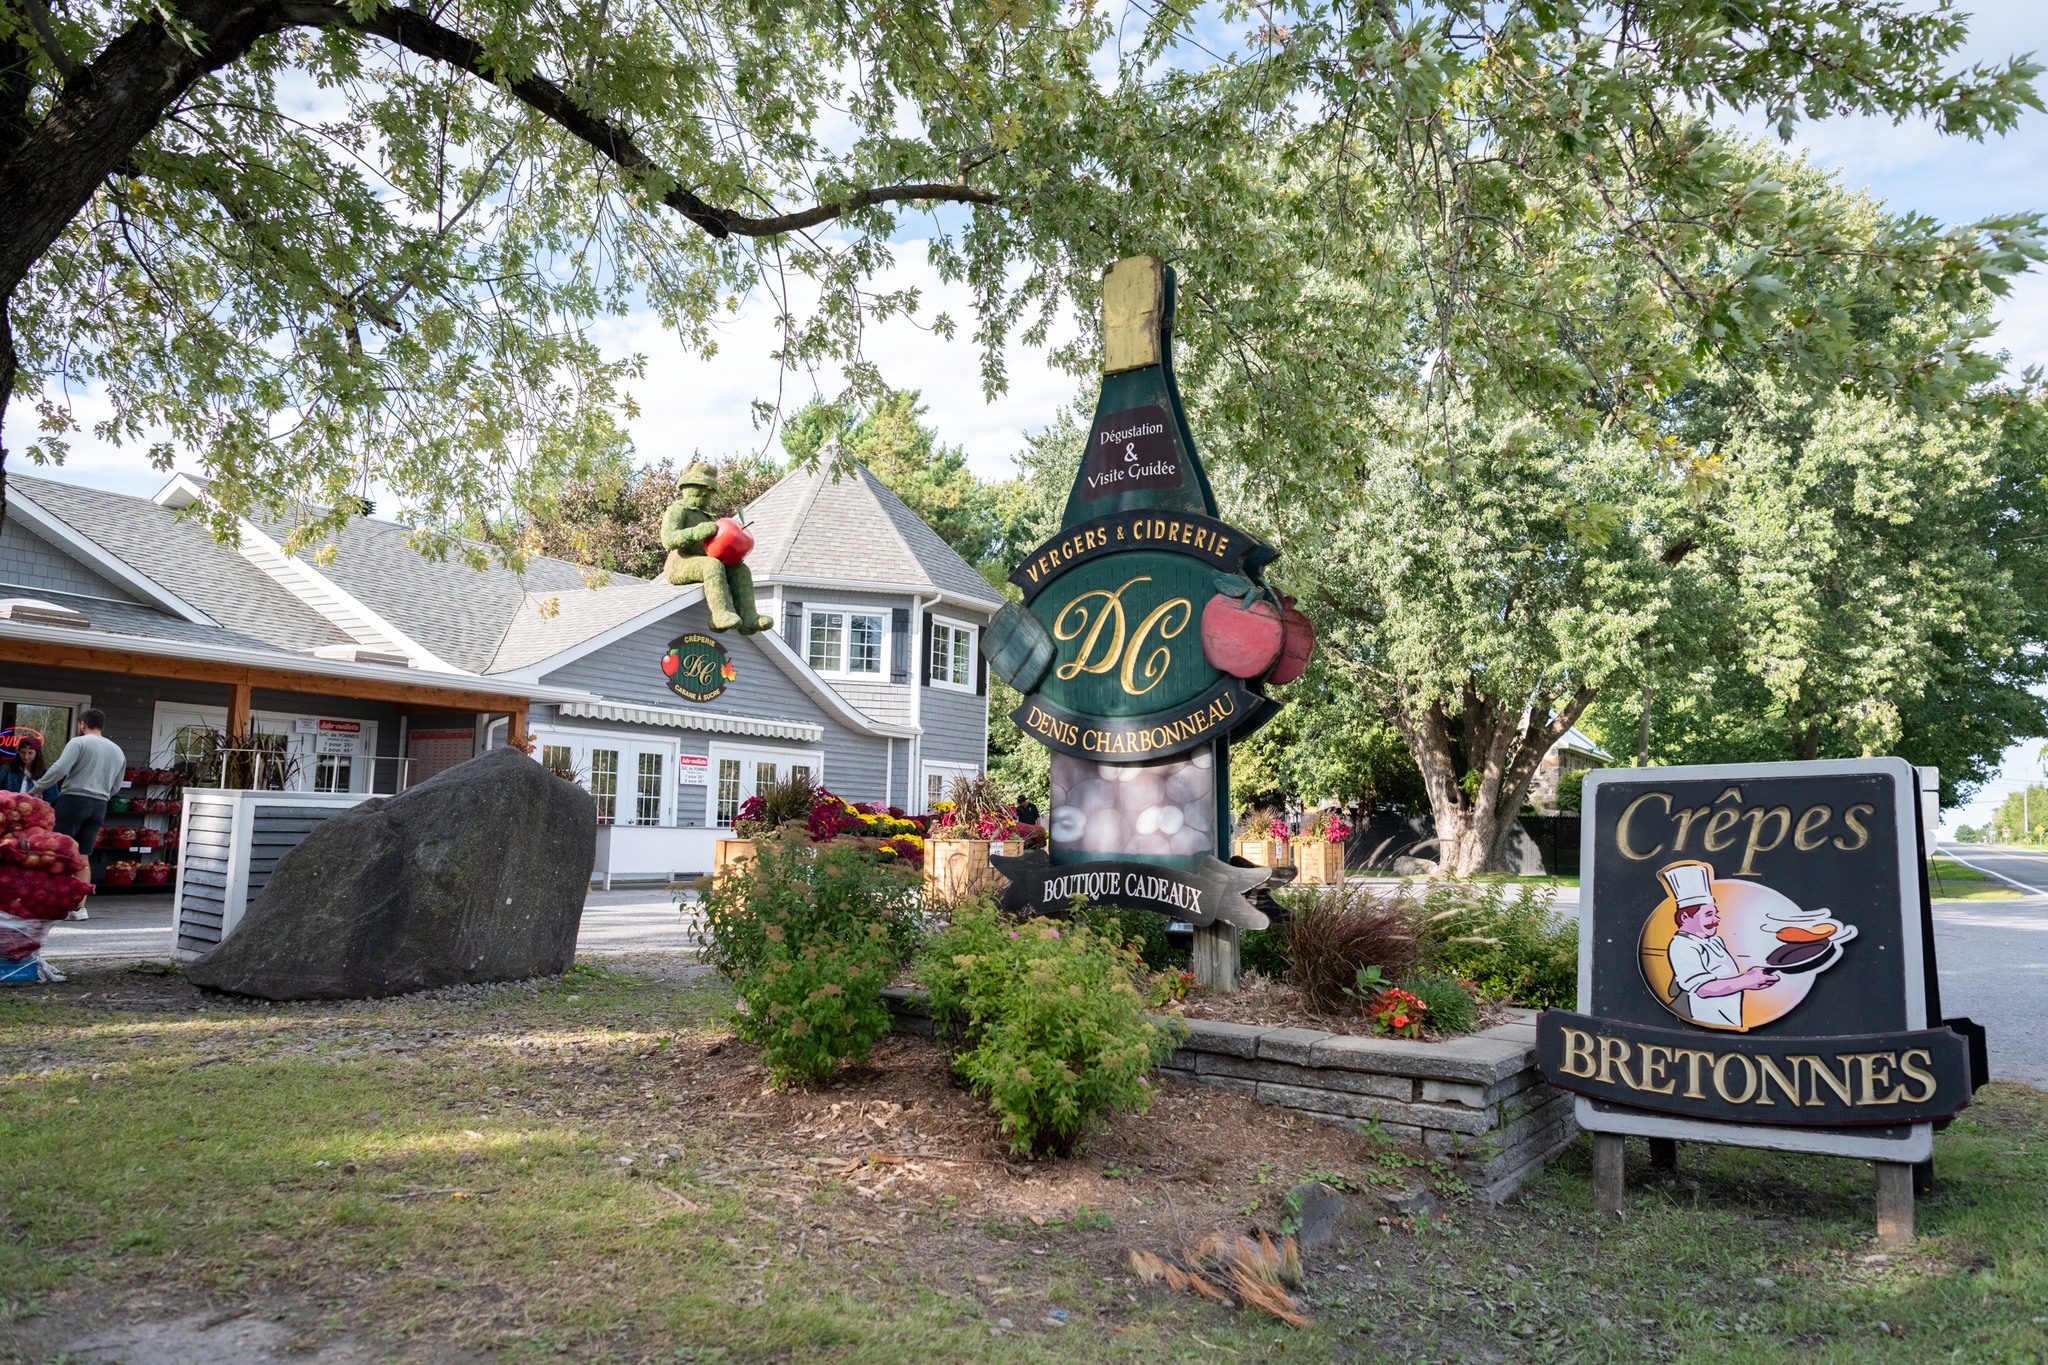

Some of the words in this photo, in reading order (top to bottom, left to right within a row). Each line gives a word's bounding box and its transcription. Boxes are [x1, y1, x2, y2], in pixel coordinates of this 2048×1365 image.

[1100, 422, 1163, 445] Dégustation
[1124, 442, 1138, 462] &
[1088, 468, 1124, 488] Visite
[1128, 460, 1176, 480] Guidée
[1026, 525, 1108, 583] VERGERS
[1116, 525, 1125, 540] &
[1133, 519, 1231, 558] CIDRERIE
[684, 634, 716, 648] CRÊPERIE
[674, 684, 697, 700] CABANE
[703, 688, 721, 701] SUCRE
[1025, 705, 1079, 746] DENIS
[1082, 691, 1236, 754] CHARBONNEAU
[1615, 786, 1876, 877] Crêpes
[1042, 872, 1121, 904] BOUTIQUE
[1125, 873, 1204, 915] CADEAUX
[1558, 1026, 1938, 1107] BRETONNES
